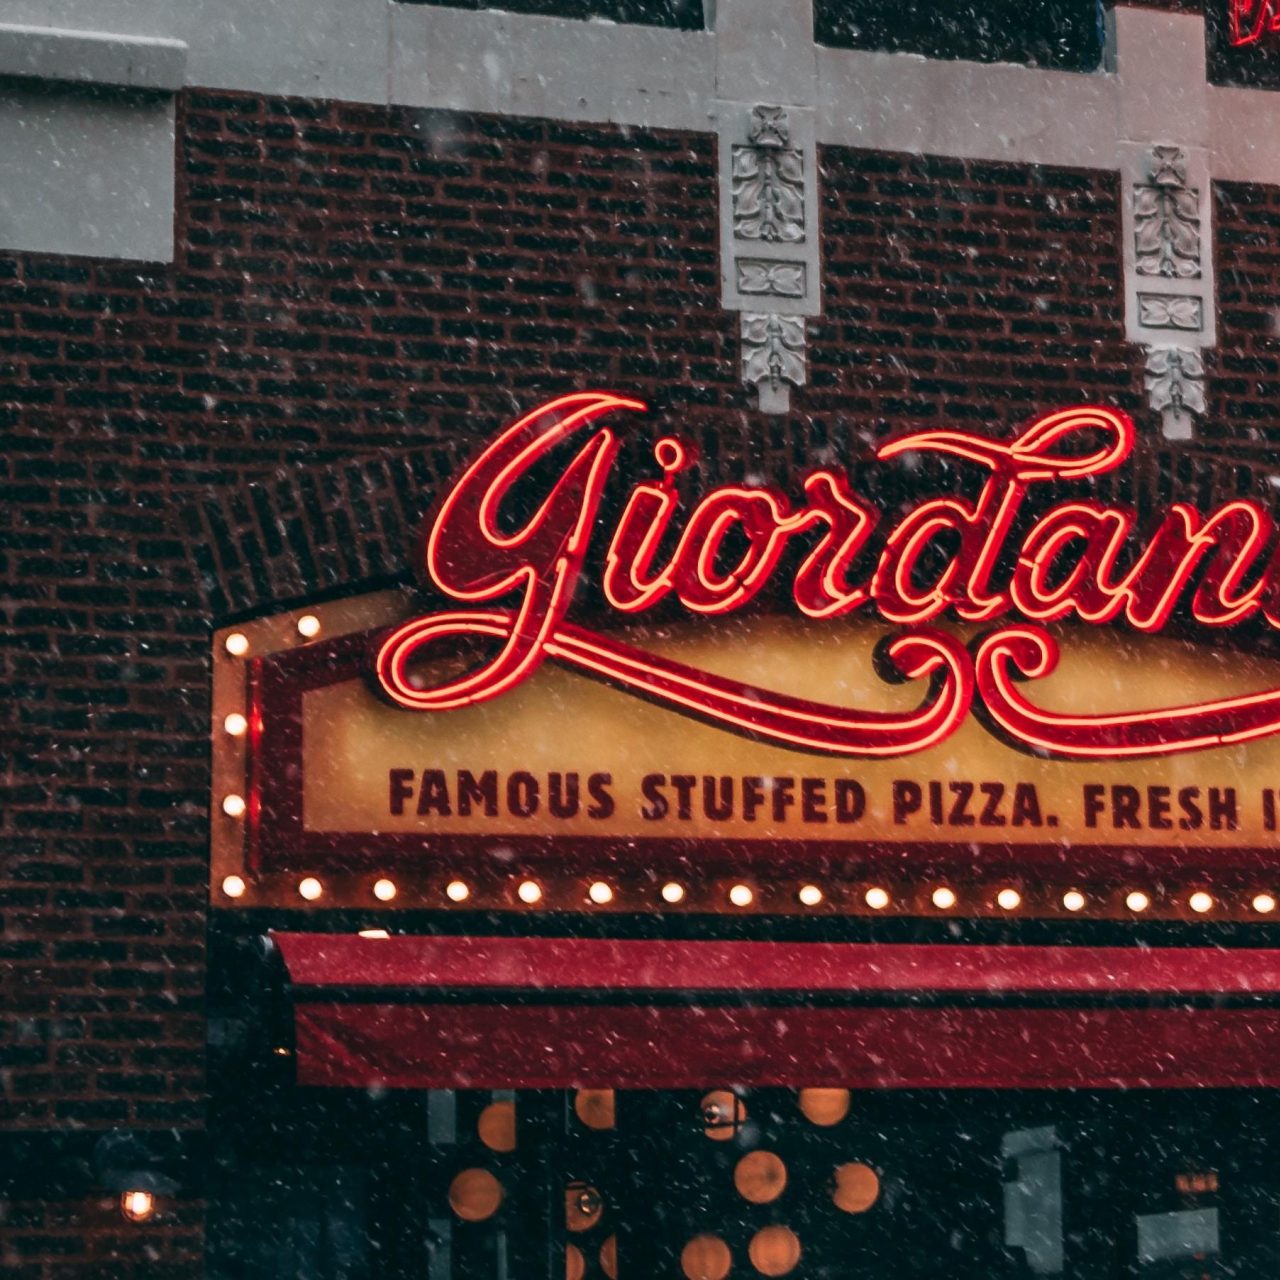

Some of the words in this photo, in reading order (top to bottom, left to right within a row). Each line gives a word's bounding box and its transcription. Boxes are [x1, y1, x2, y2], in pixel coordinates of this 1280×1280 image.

[389, 768, 616, 818] FAMOUS
[641, 773, 868, 823] STUFFED
[891, 780, 1060, 828] PIZZA.
[1083, 785, 1239, 832] FRESH
